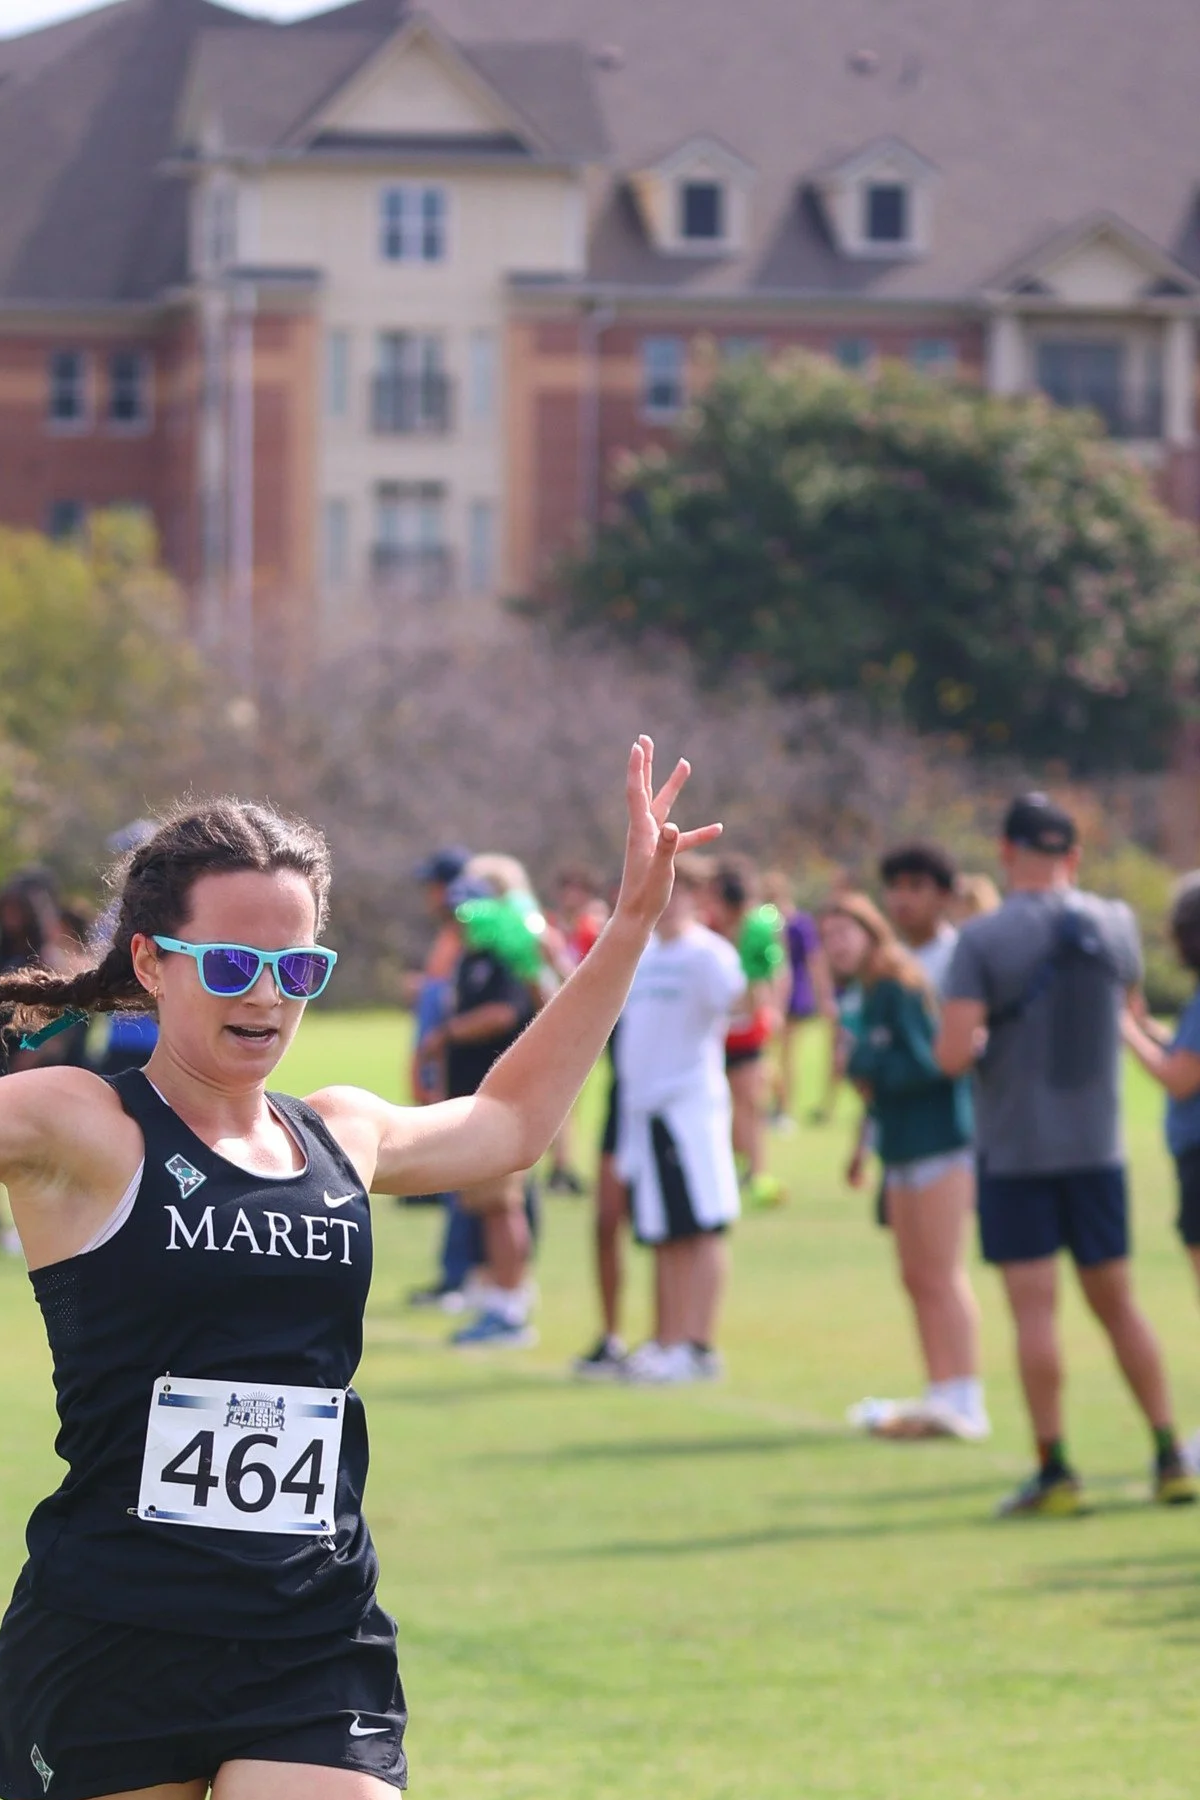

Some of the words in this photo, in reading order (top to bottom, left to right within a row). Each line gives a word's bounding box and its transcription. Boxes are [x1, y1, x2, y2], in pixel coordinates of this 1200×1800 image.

[163, 1205, 360, 1265] MARET
[231, 1411, 280, 1427] CLASSIC
[160, 1430, 325, 1515] 464
